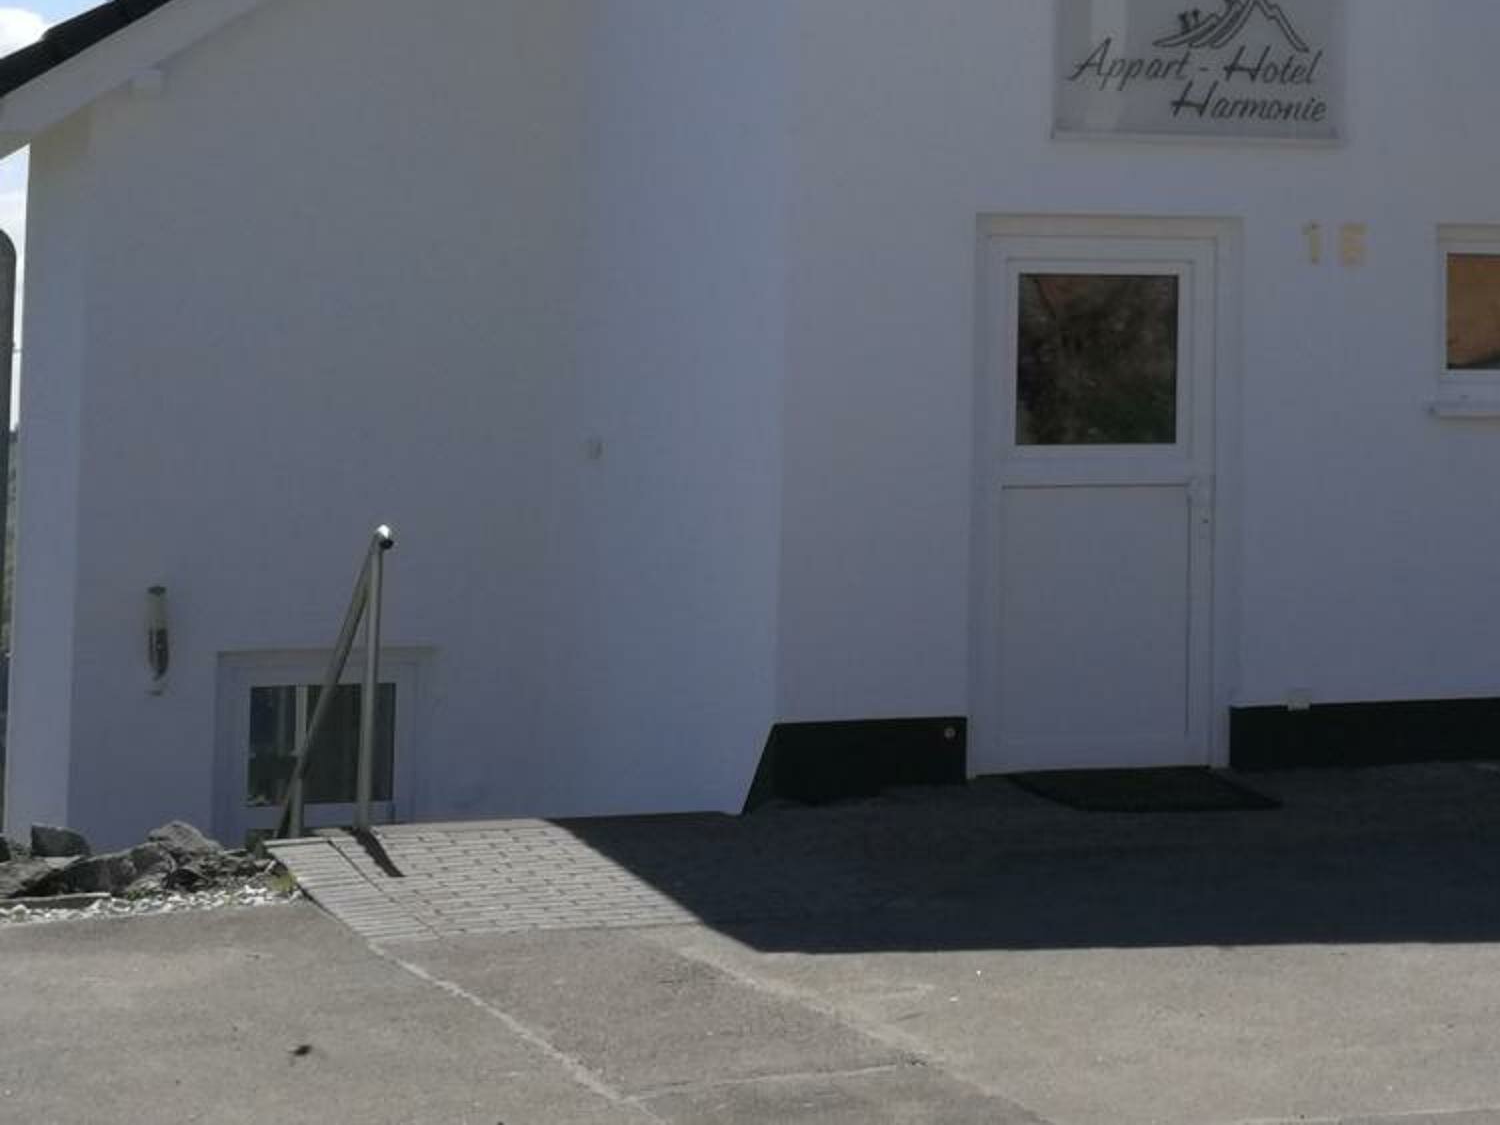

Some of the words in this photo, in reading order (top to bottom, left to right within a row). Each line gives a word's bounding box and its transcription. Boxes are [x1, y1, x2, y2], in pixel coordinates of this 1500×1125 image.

[1069, 37, 1190, 91] Appart
[1222, 45, 1323, 85] Hotel
[1170, 80, 1328, 121] Harmonie
